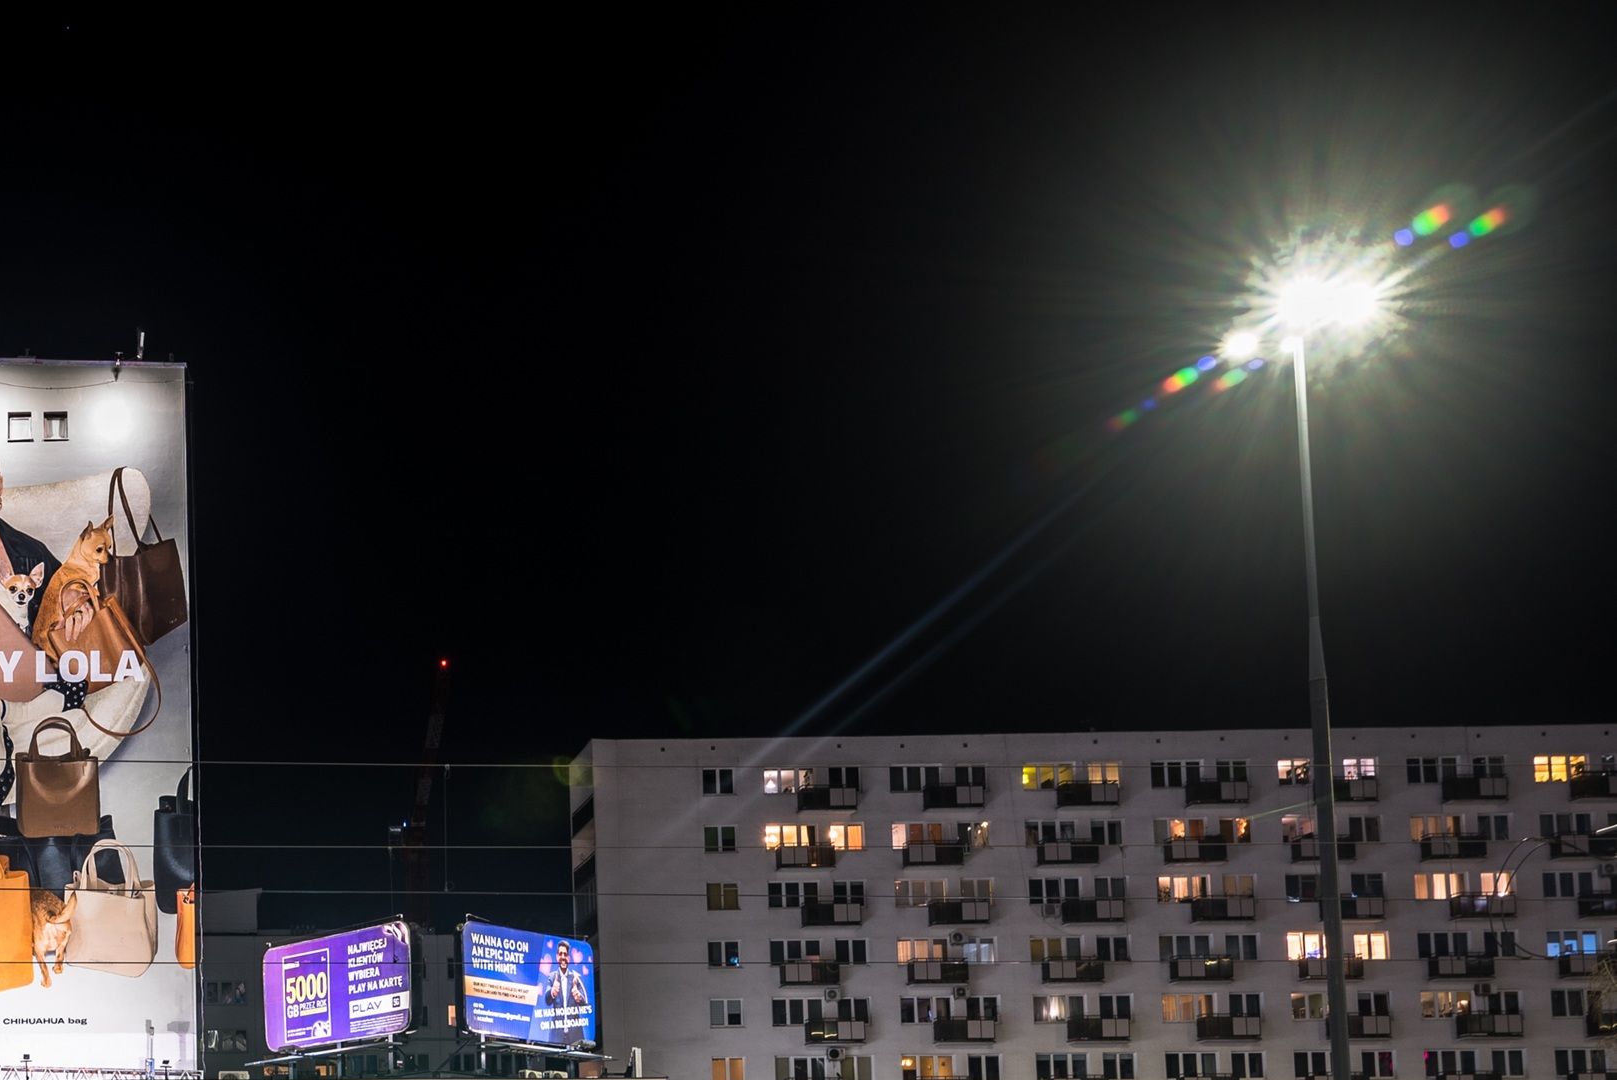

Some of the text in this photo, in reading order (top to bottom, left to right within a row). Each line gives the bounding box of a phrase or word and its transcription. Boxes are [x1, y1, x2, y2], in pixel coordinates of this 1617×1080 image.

[35, 650, 145, 683] LOLA
[348, 938, 387, 955] NAJWIĘCEJ
[471, 933, 529, 953] WANNA GO ON
[348, 952, 384, 968] KLIENTÓW
[472, 945, 525, 963] AN EPIC DATE
[472, 957, 494, 971] WITH
[348, 967, 380, 981] WYBIERA
[286, 971, 327, 1004] 5000
[348, 976, 403, 995] PLAY NA KARTĘ
[287, 999, 327, 1019] GB PRZEZ ROK
[352, 1000, 382, 1013] PLAY
[2, 1017, 65, 1026] CHIHUAHUA
[68, 1017, 88, 1026] bag
